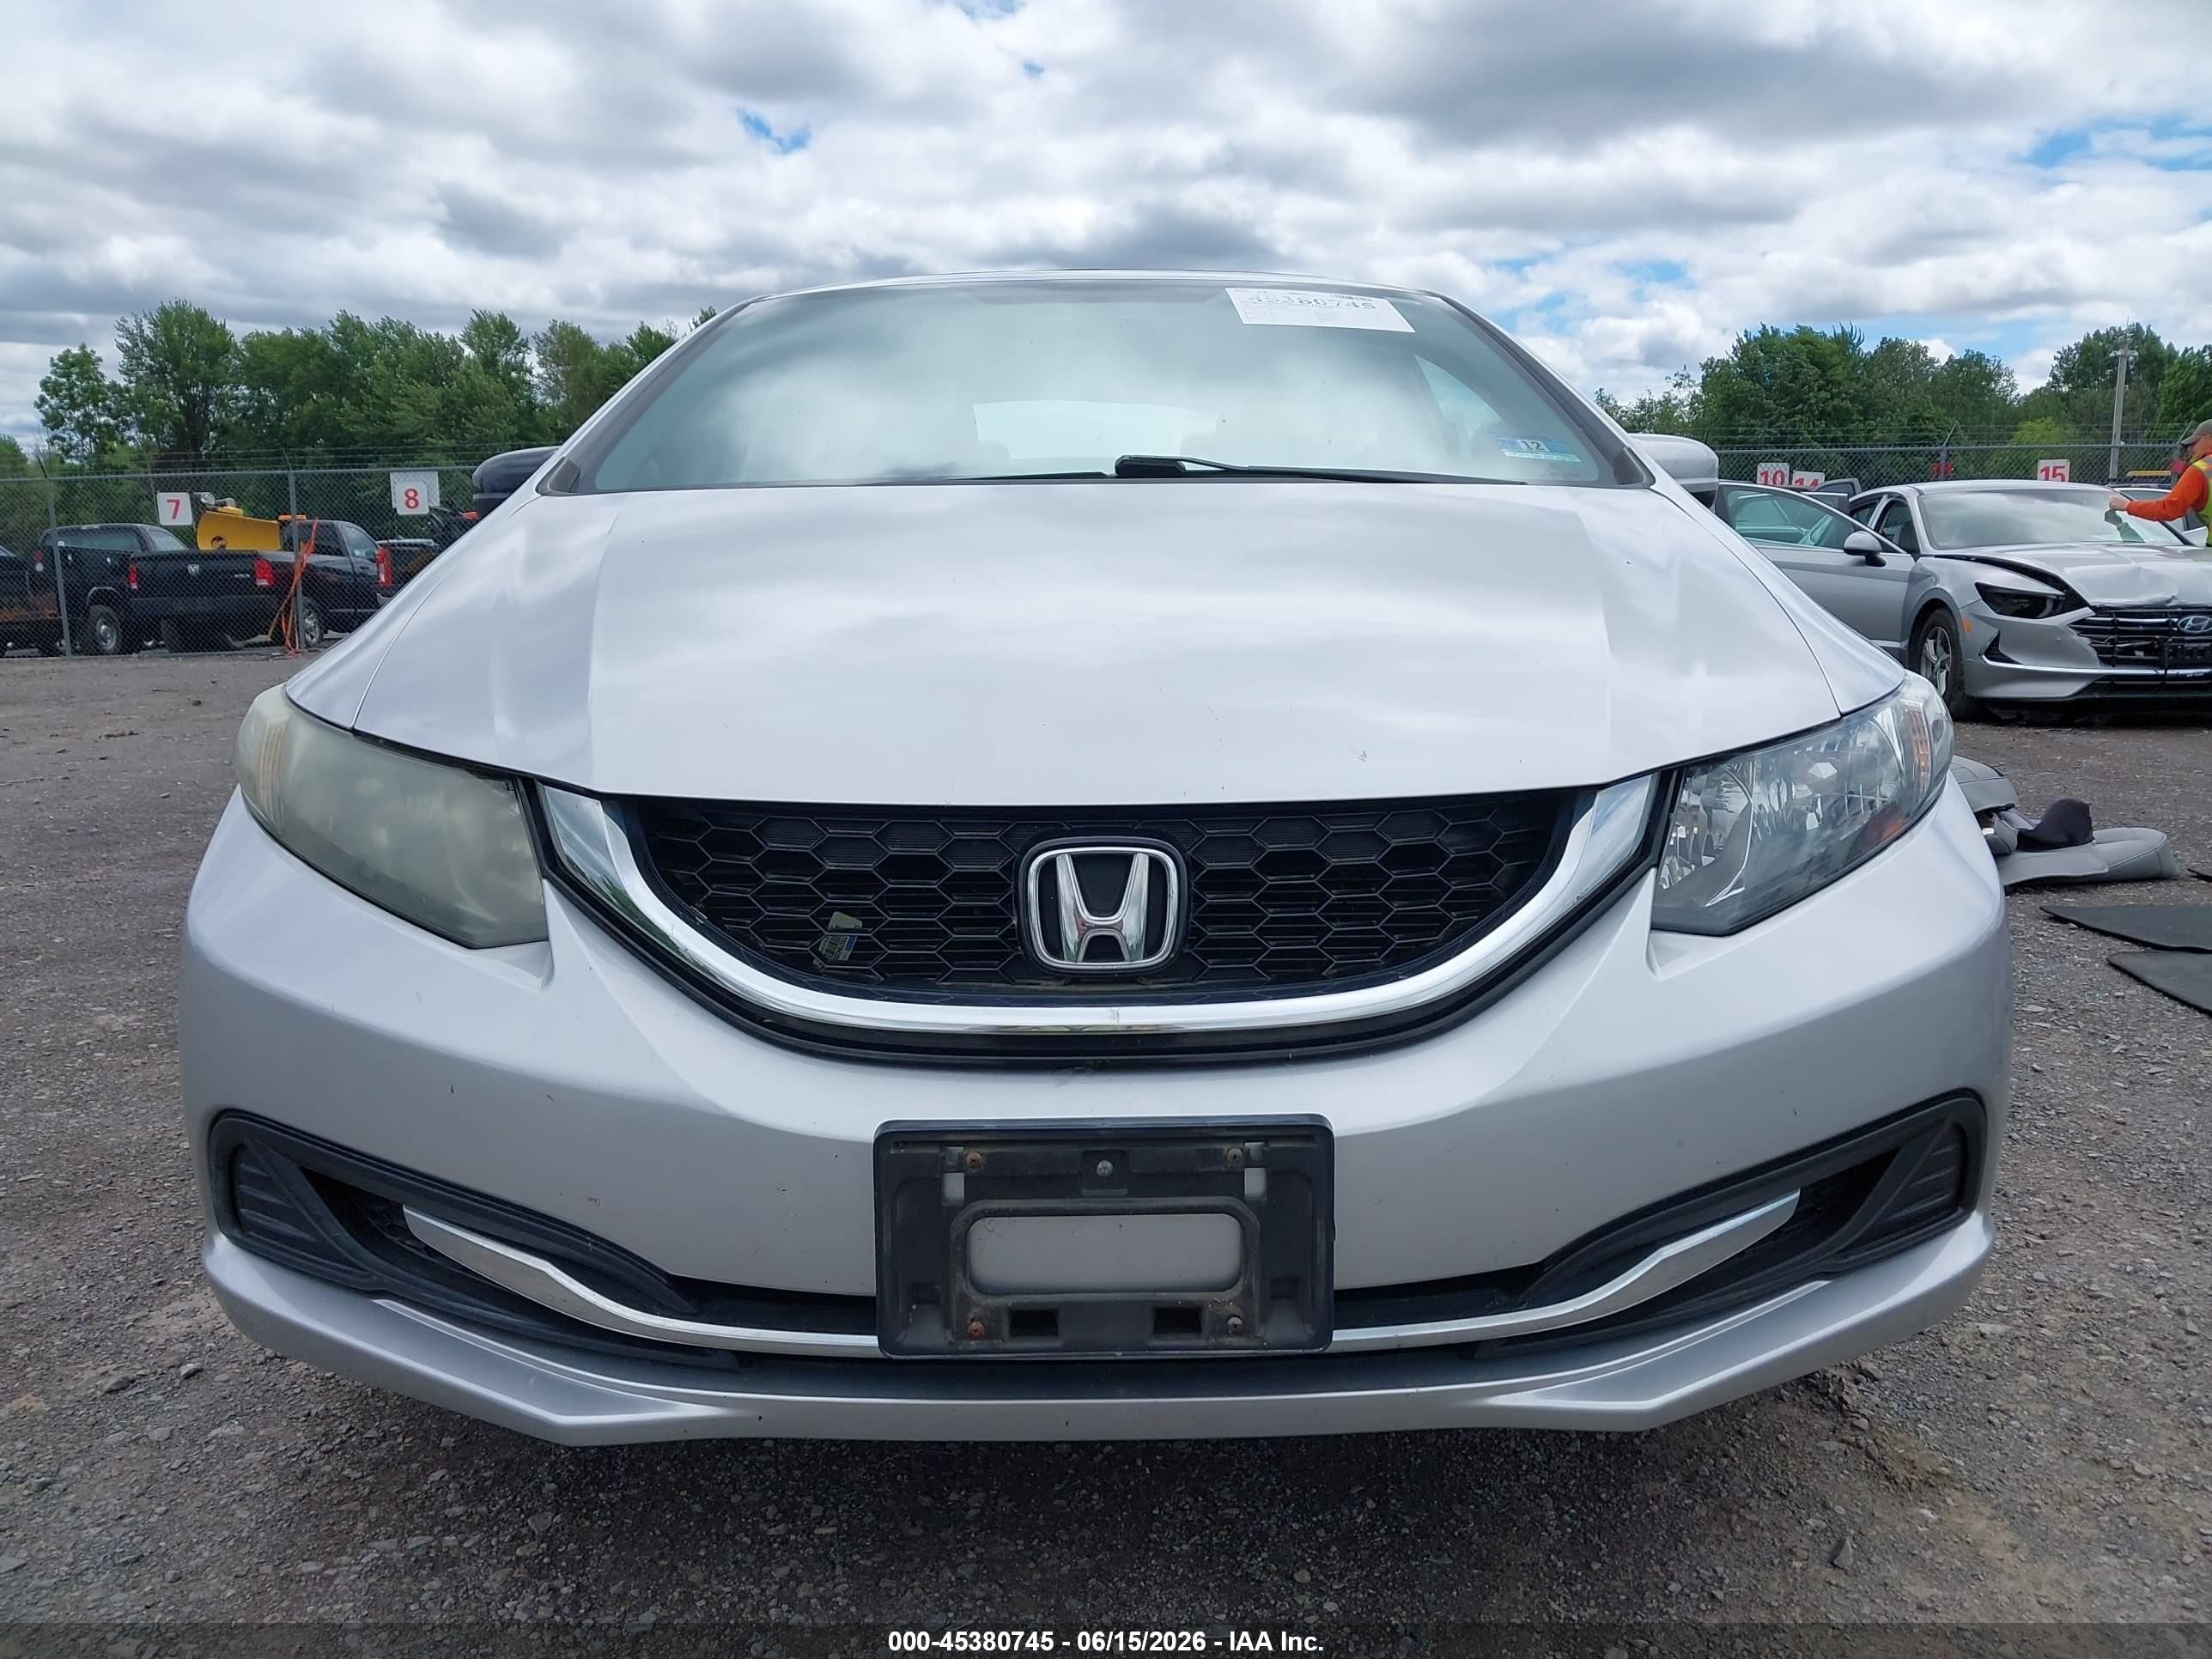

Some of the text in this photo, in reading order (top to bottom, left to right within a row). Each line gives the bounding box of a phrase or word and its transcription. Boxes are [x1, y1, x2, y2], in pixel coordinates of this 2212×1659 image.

[1760, 470, 1785, 485] 10
[2040, 466, 2065, 482] 15
[404, 488, 419, 508] 8
[167, 499, 180, 520] 7
